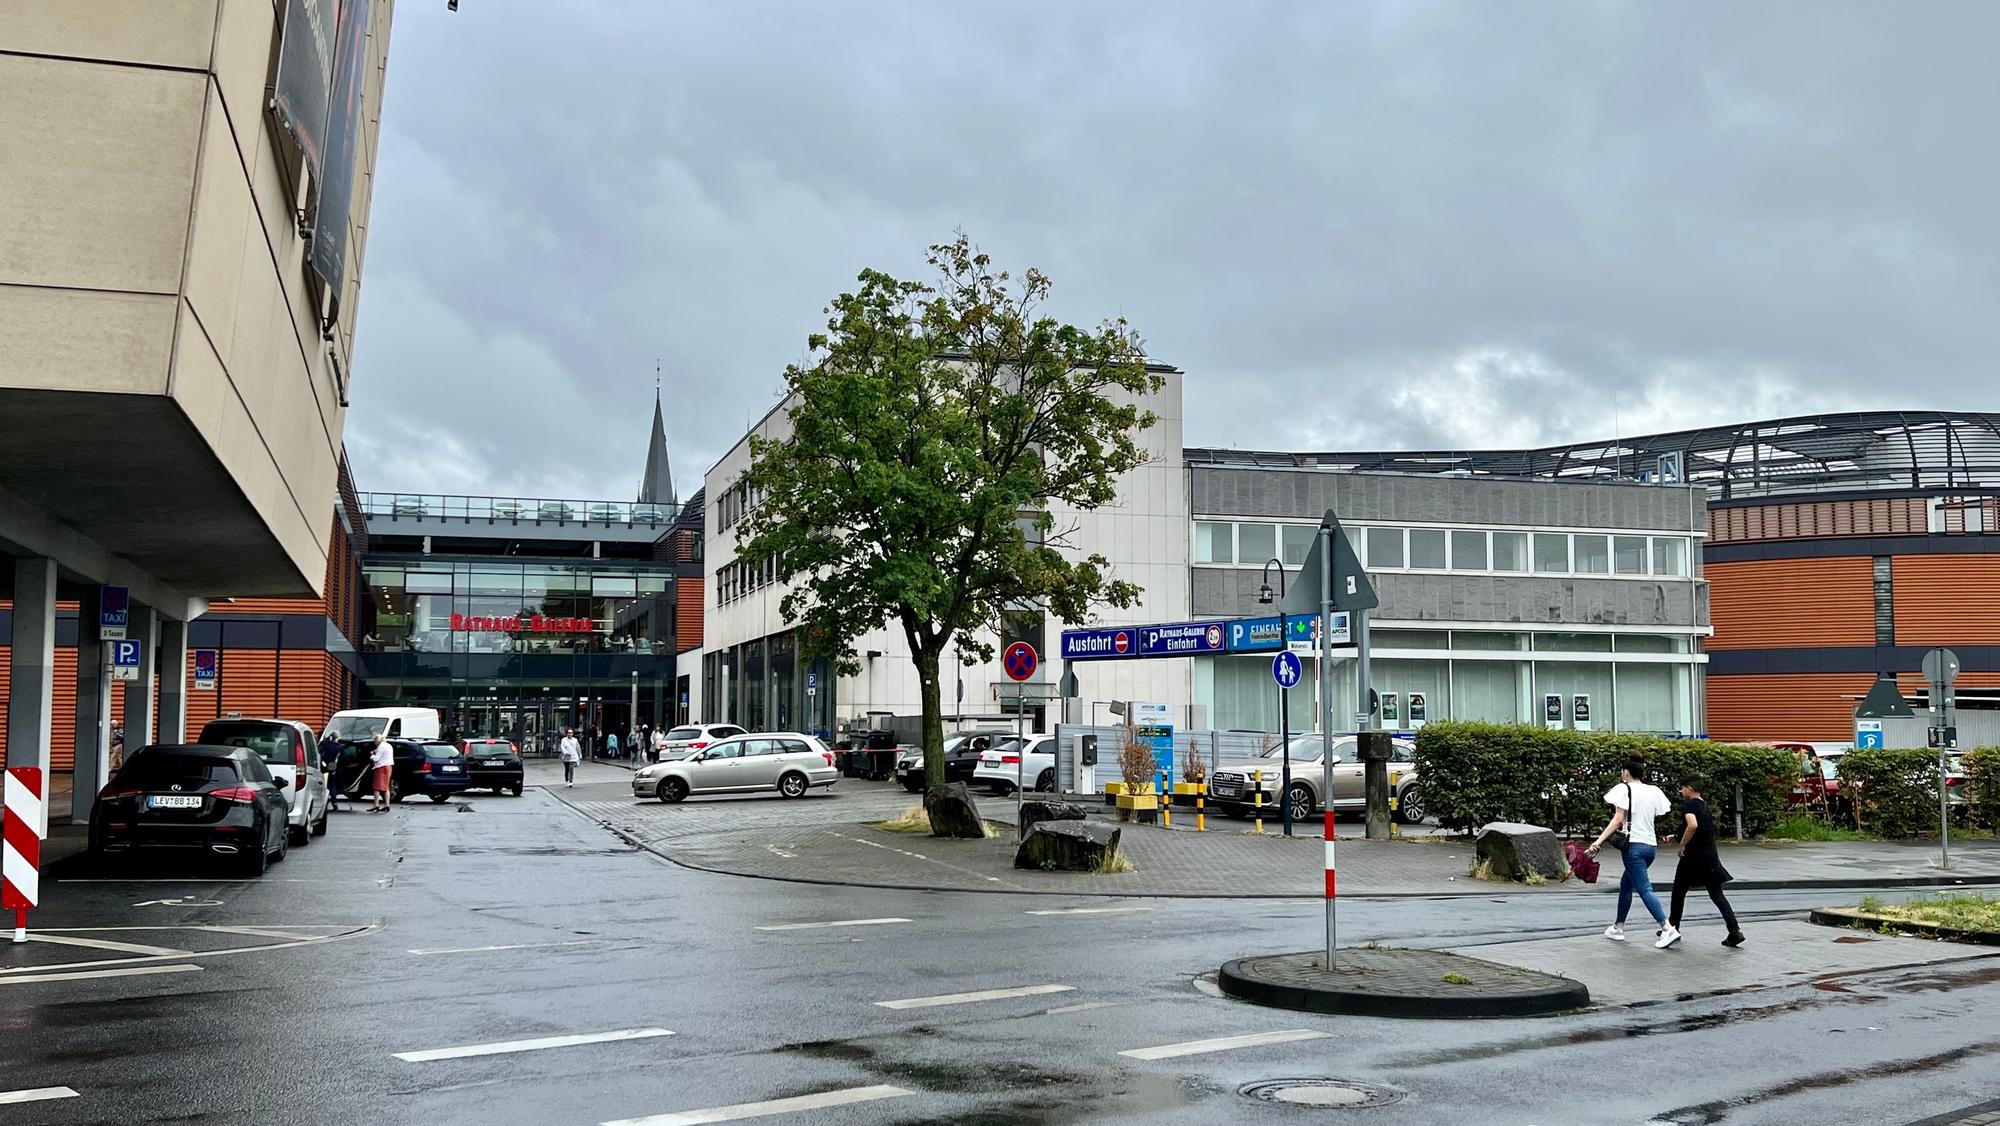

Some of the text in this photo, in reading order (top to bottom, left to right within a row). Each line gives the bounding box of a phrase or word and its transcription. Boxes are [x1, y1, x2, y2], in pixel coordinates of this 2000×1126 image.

[104, 613, 126, 622] TAXI
[450, 613, 593, 632] RATHAUS GALERIE
[1150, 627, 1206, 648] P RATHAUS-GALERIE
[1233, 621, 1293, 646] P EINFAHT
[1068, 635, 1112, 653] Ausfahrt
[1167, 637, 1198, 650] Einfahrt
[120, 643, 134, 663] P
[197, 670, 214, 678] TAXI
[1867, 737, 1876, 748] P
[154, 796, 170, 805] LEV
[186, 797, 200, 806] 134
